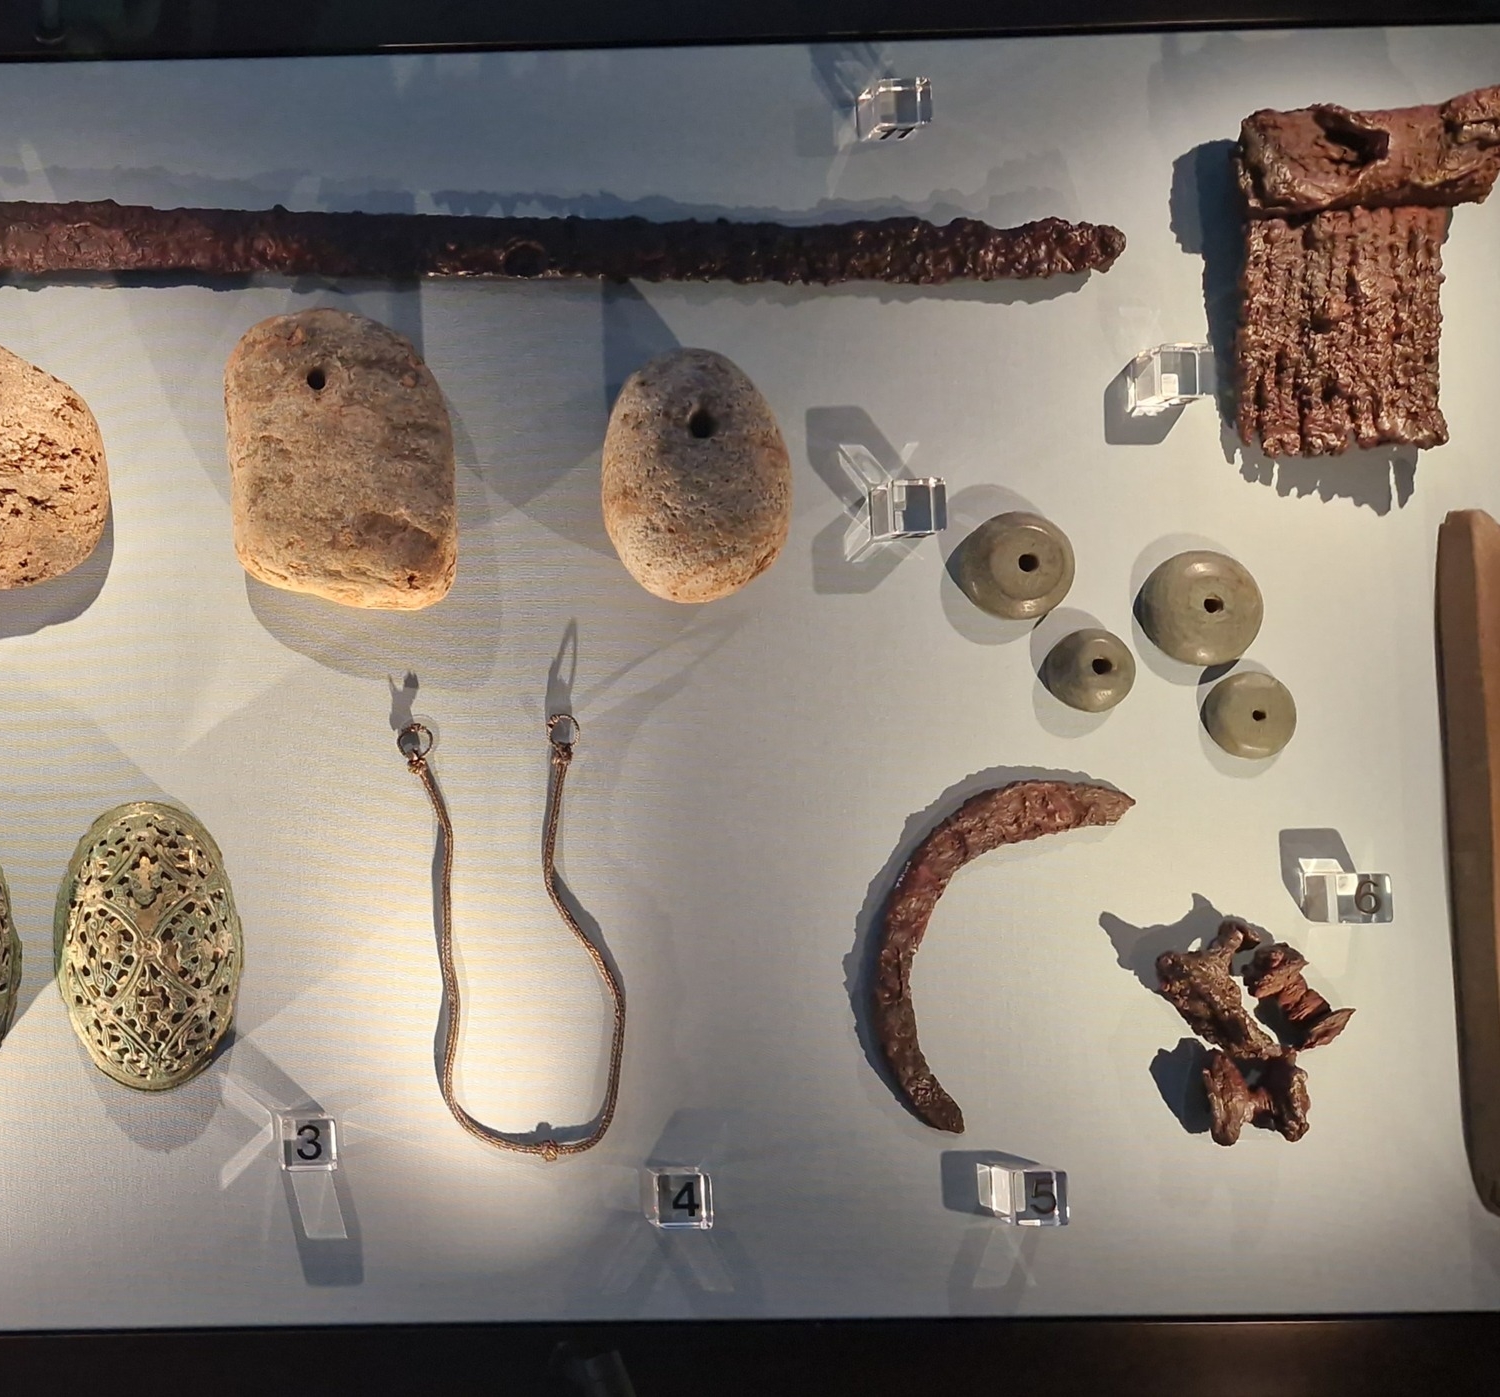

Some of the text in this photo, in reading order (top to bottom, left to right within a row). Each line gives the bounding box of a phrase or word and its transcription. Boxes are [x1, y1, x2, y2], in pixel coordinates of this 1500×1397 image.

[1355, 880, 1381, 914] 6
[297, 1125, 322, 1160] 3
[673, 1182, 699, 1217] 4
[1031, 1179, 1056, 1214] 5
